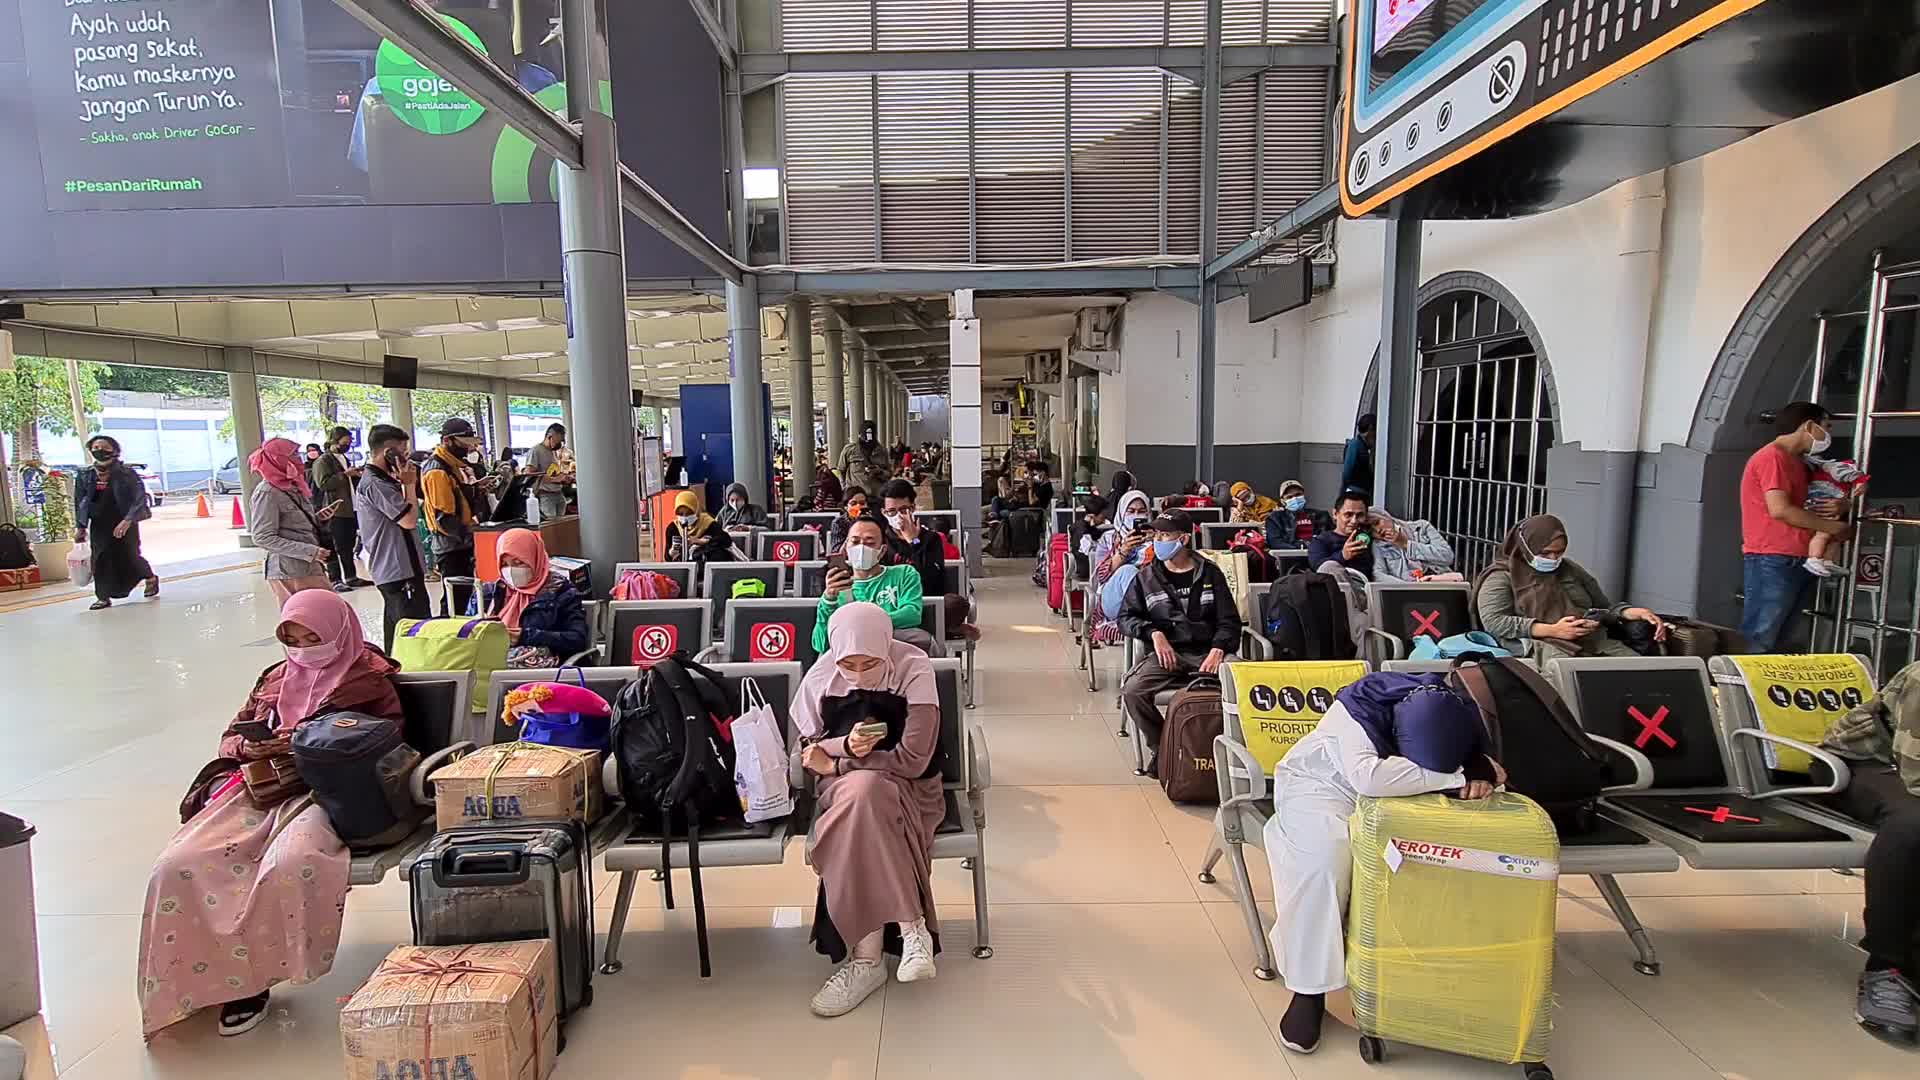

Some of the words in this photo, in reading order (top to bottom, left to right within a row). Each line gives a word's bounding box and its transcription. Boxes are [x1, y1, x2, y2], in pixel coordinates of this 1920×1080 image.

[71, 13, 119, 40] Ayah
[126, 10, 170, 33] udah
[74, 43, 138, 67] pasang
[134, 64, 236, 85] maskernya
[403, 78, 458, 97] goje
[154, 92, 210, 113] Turun
[164, 126, 199, 139] Driver
[64, 178, 202, 193] #PesanDariRumah
[1762, 669, 1794, 680] SEAT
[1798, 670, 1856, 681] PRIORITY
[1194, 758, 1216, 771] TRA
